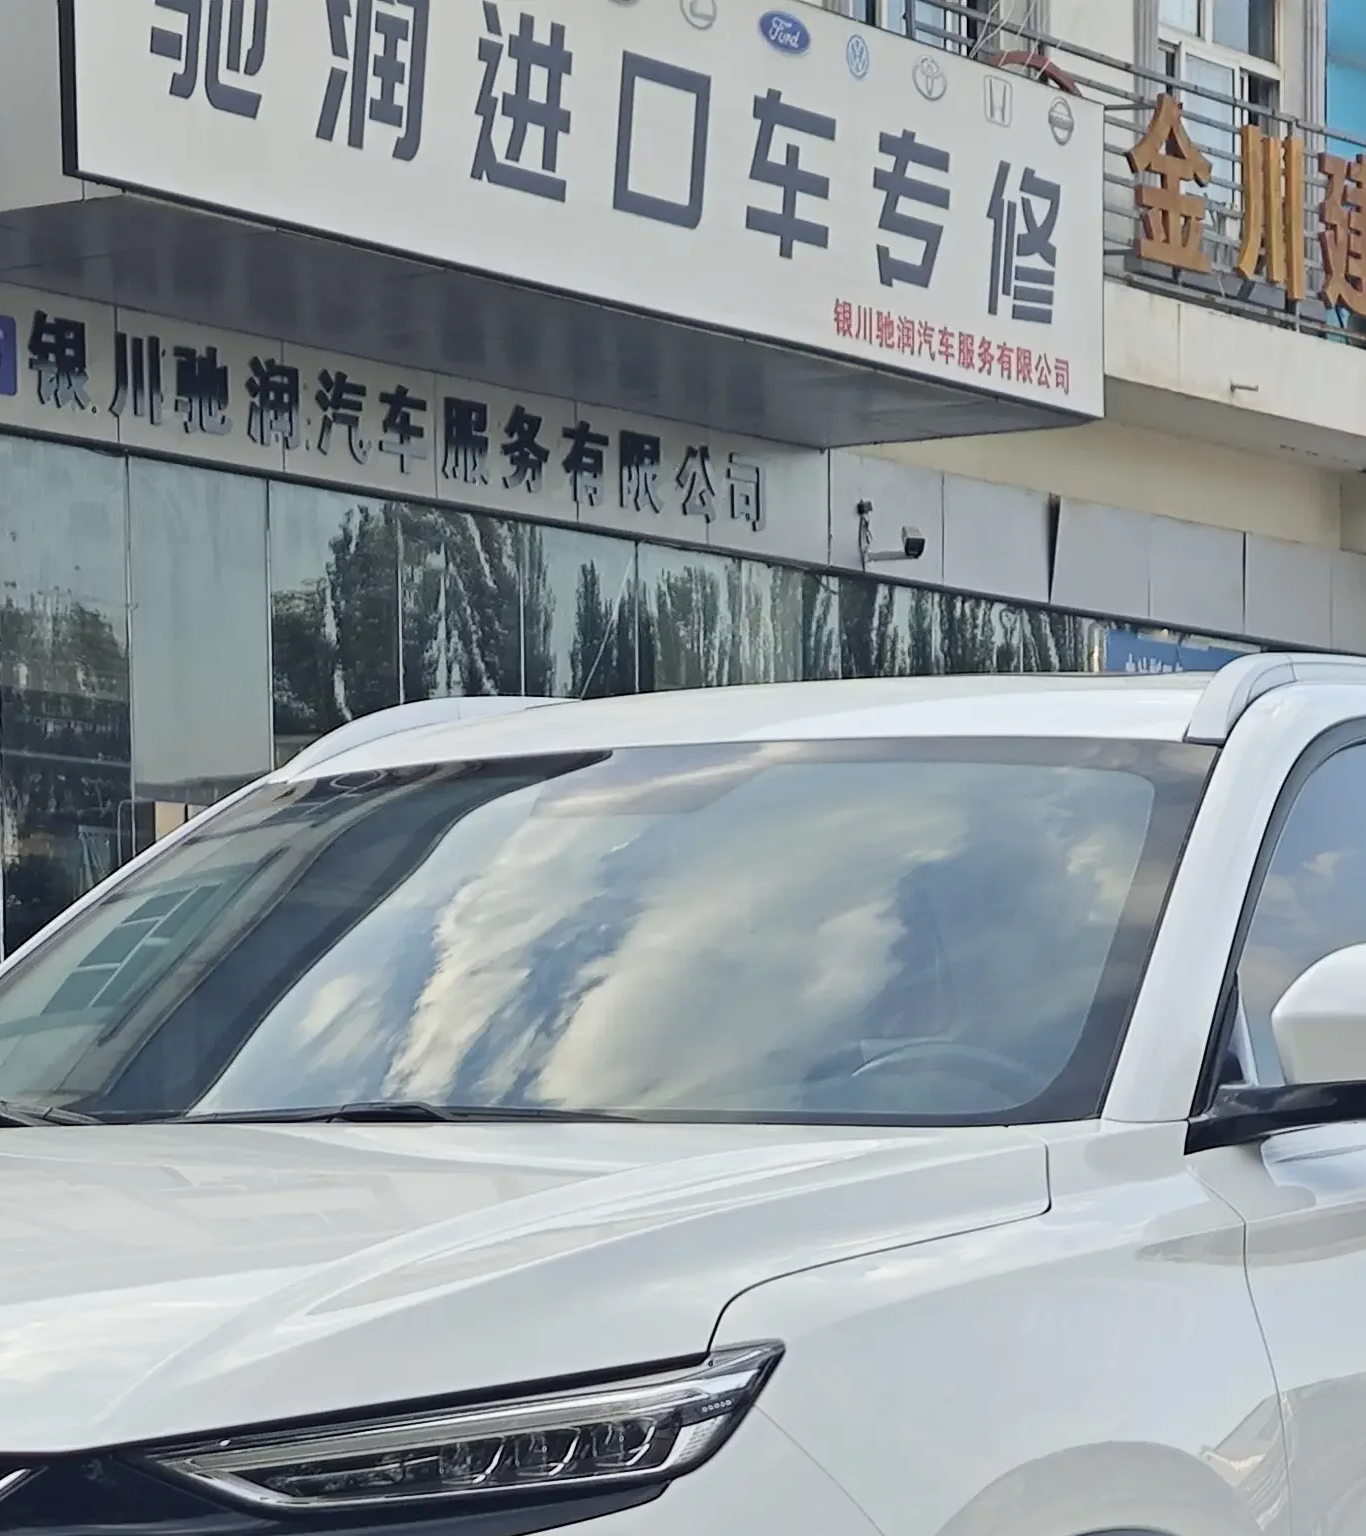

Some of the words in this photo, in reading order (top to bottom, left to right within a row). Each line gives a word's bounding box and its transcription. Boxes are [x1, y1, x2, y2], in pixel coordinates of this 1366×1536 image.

[27, 308, 768, 533] 银川驰润汽车服务有限公司
[833, 298, 1070, 396] 银川驰润汽车服务有限公司
